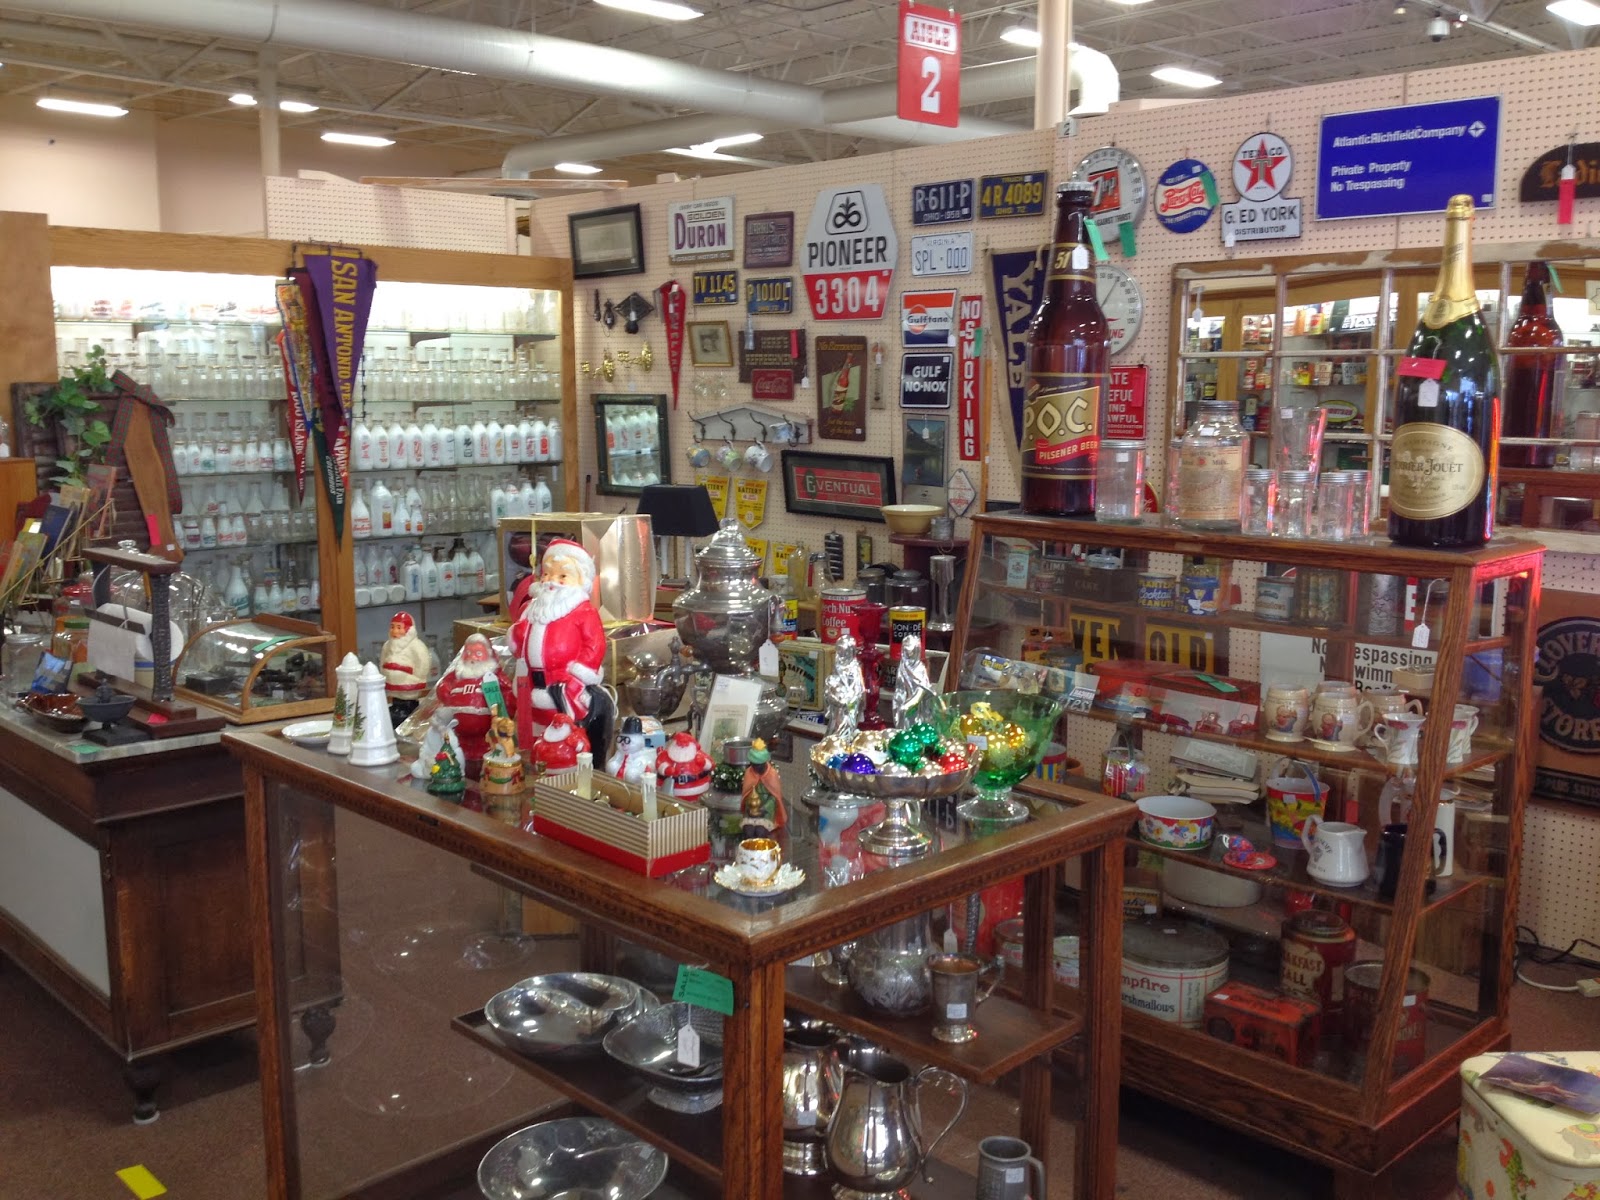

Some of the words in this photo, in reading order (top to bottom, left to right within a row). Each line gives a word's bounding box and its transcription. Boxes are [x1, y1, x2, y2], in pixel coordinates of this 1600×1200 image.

[920, 56, 940, 113] 2
[1242, 146, 1283, 159] TEXACO
[1331, 165, 1364, 177] Private
[1368, 160, 1412, 175] Property
[1004, 182, 1042, 204] 4089
[1331, 181, 1344, 192] No
[1346, 177, 1405, 192] Trespassing
[915, 183, 971, 212] R-611-P
[687, 210, 725, 221] GOLDEN
[1224, 210, 1236, 224] G.
[1239, 209, 1256, 223] ED
[1261, 205, 1297, 221] YORK
[674, 212, 726, 251] DURON
[1235, 225, 1287, 235] DISTRIBUTOR
[807, 235, 888, 268] PIONEER
[331, 260, 358, 305] SAN
[709, 274, 736, 294] 1145
[815, 275, 880, 315] 3304
[906, 313, 951, 324] Gulftane
[961, 299, 980, 320] NO
[912, 365, 942, 378] GULF
[905, 380, 947, 393] NO-NOX
[963, 320, 976, 457] SMOKING
[1039, 443, 1078, 460] PILSENER
[1080, 440, 1098, 451] BEER
[805, 468, 875, 497] EVENTUAL
[679, 971, 689, 998] SALE
